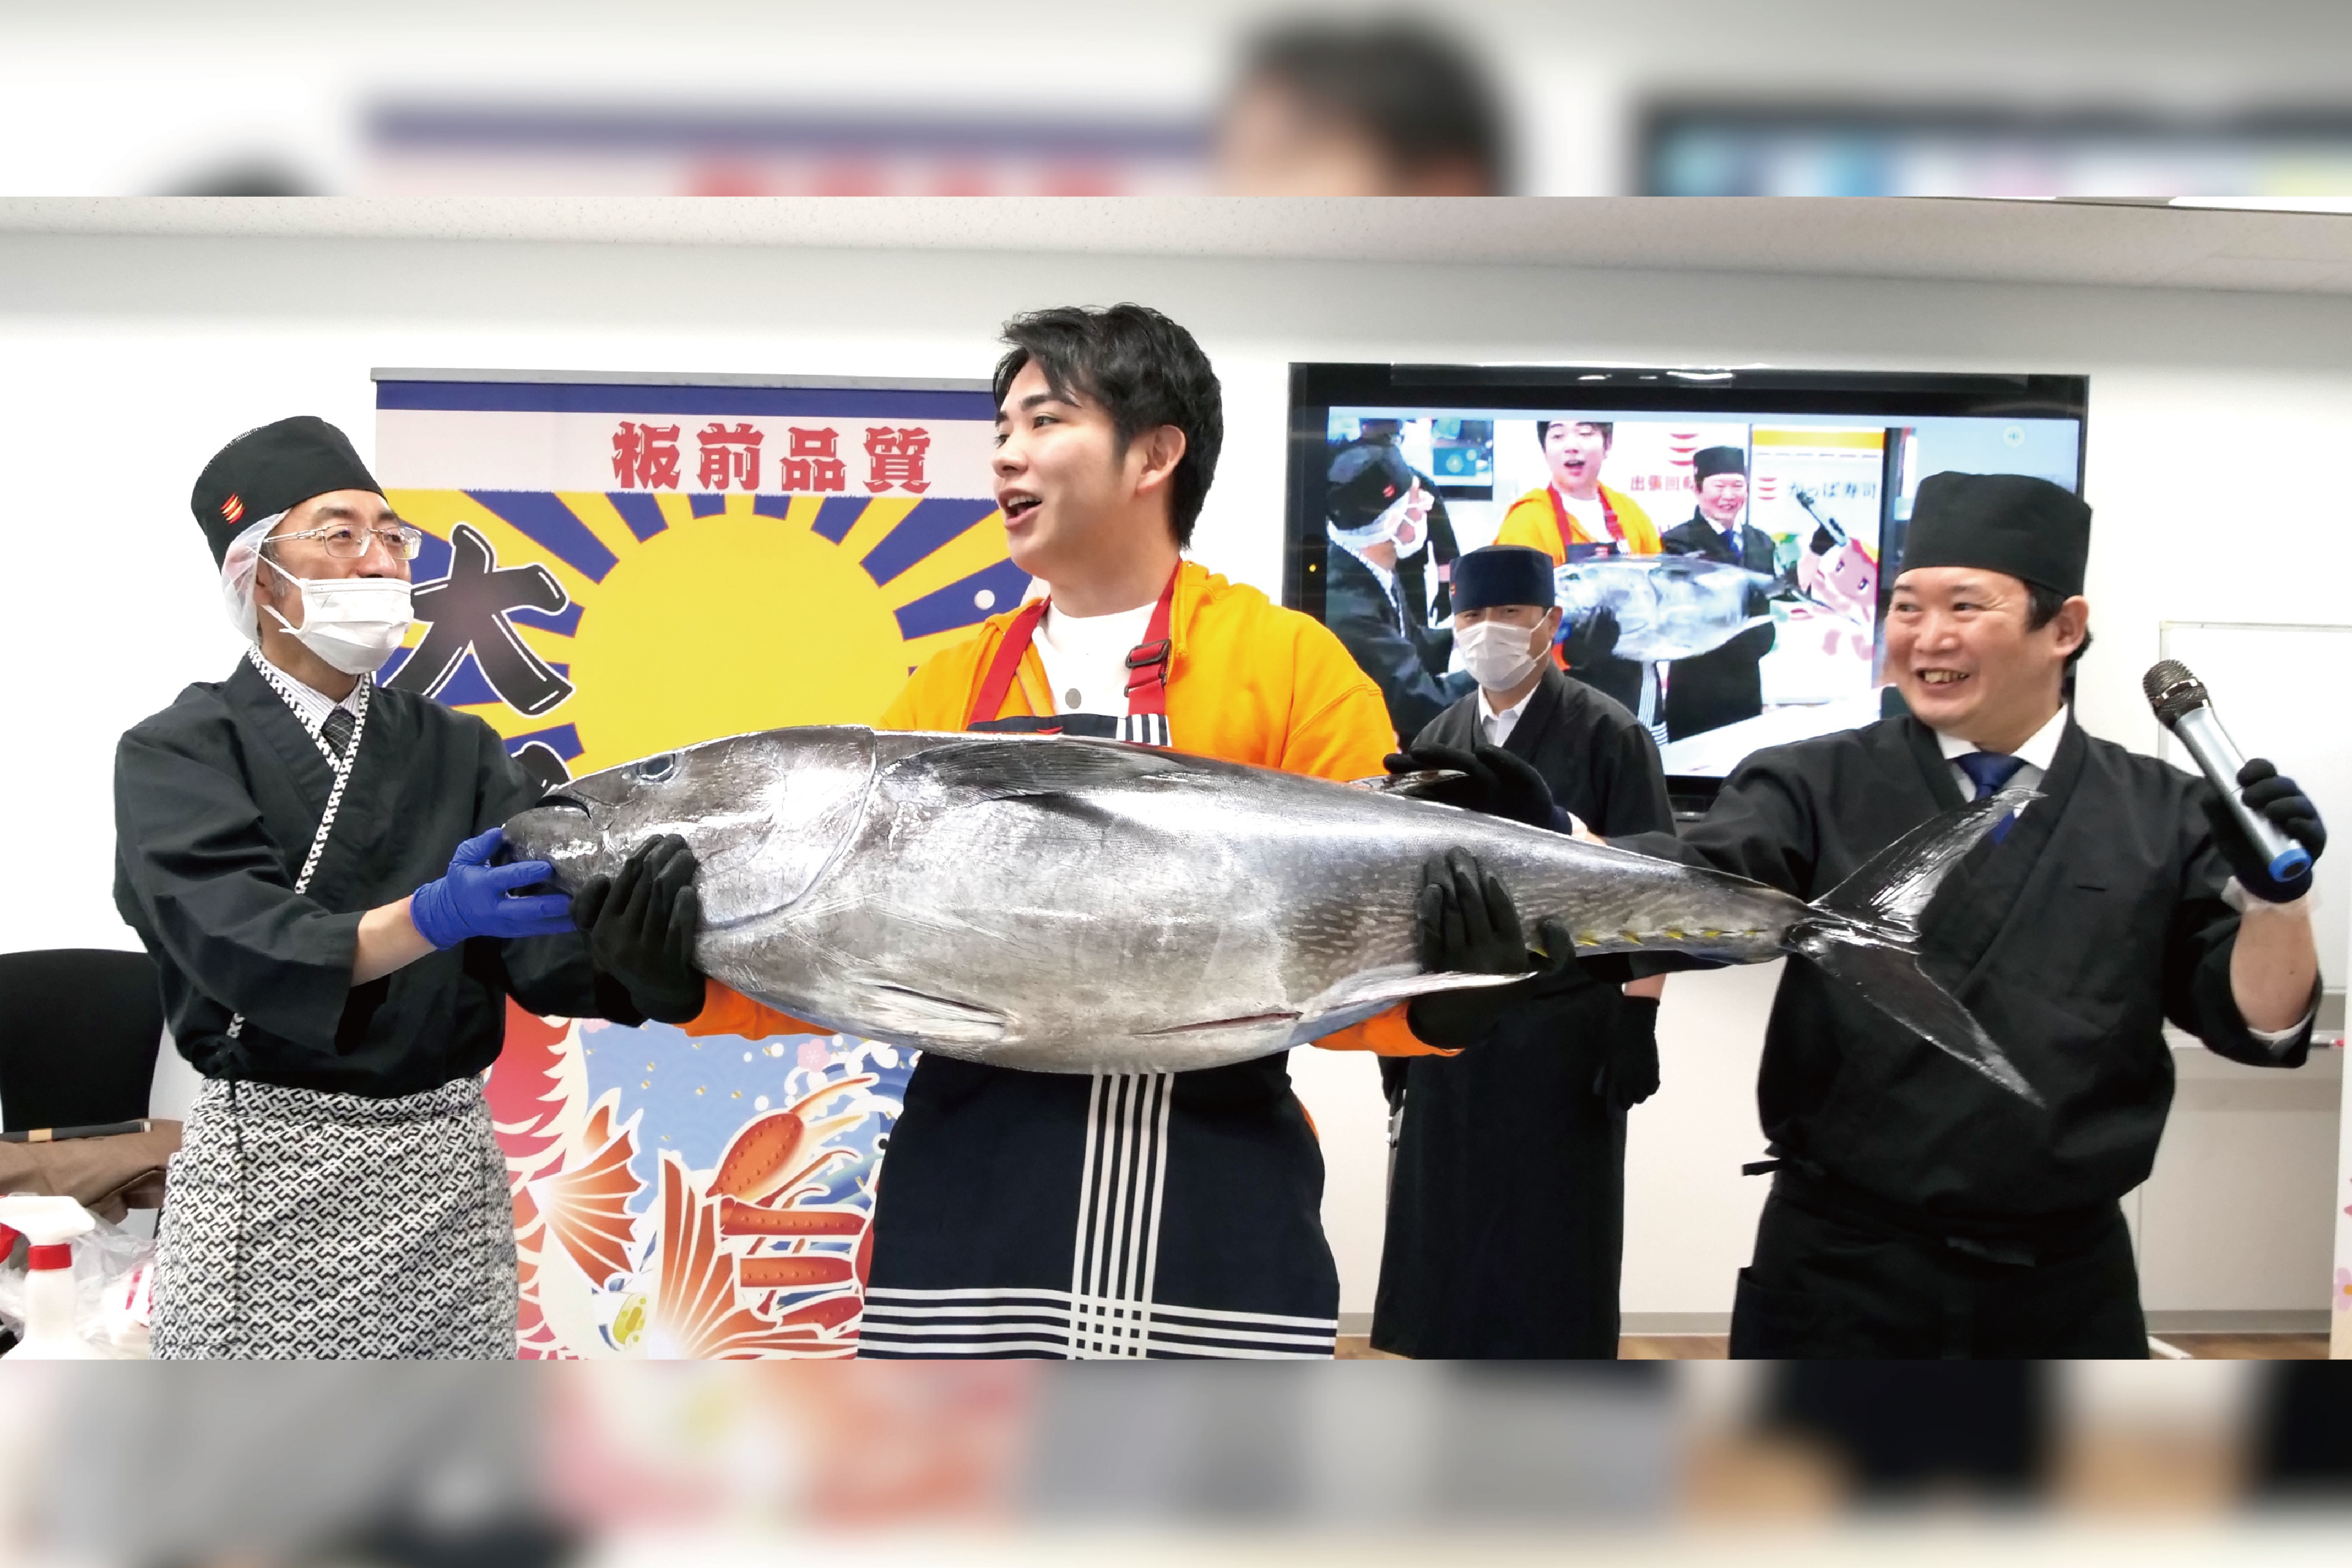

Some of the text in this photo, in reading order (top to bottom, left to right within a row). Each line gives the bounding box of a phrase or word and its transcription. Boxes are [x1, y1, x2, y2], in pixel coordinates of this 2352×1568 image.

[612, 421, 932, 494] 板前品質
[383, 522, 576, 790] 大
